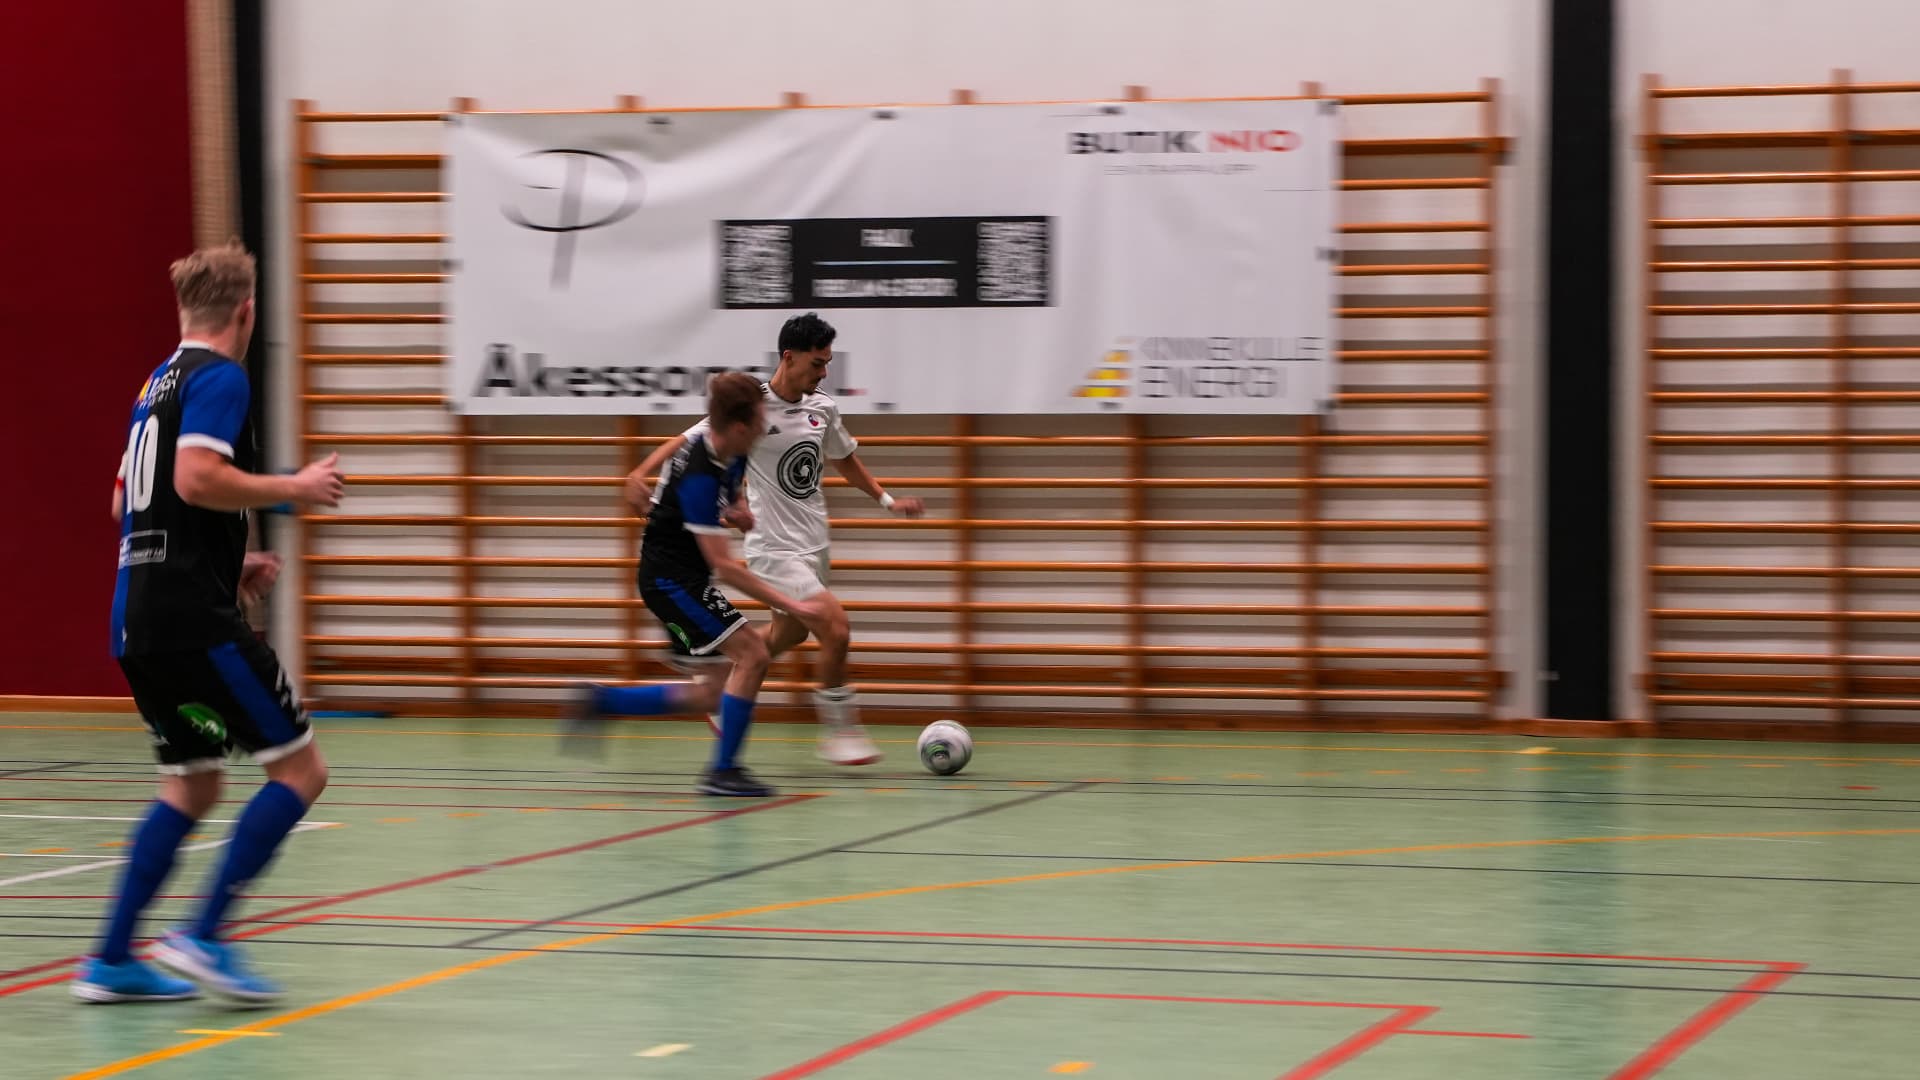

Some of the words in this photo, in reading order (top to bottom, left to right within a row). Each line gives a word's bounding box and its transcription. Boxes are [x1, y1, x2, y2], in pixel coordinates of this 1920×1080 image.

[1069, 131, 1201, 154] BUTIK
[1207, 130, 1302, 153] NIO
[1140, 366, 1288, 399] ENERGI
[127, 414, 159, 513] 10
